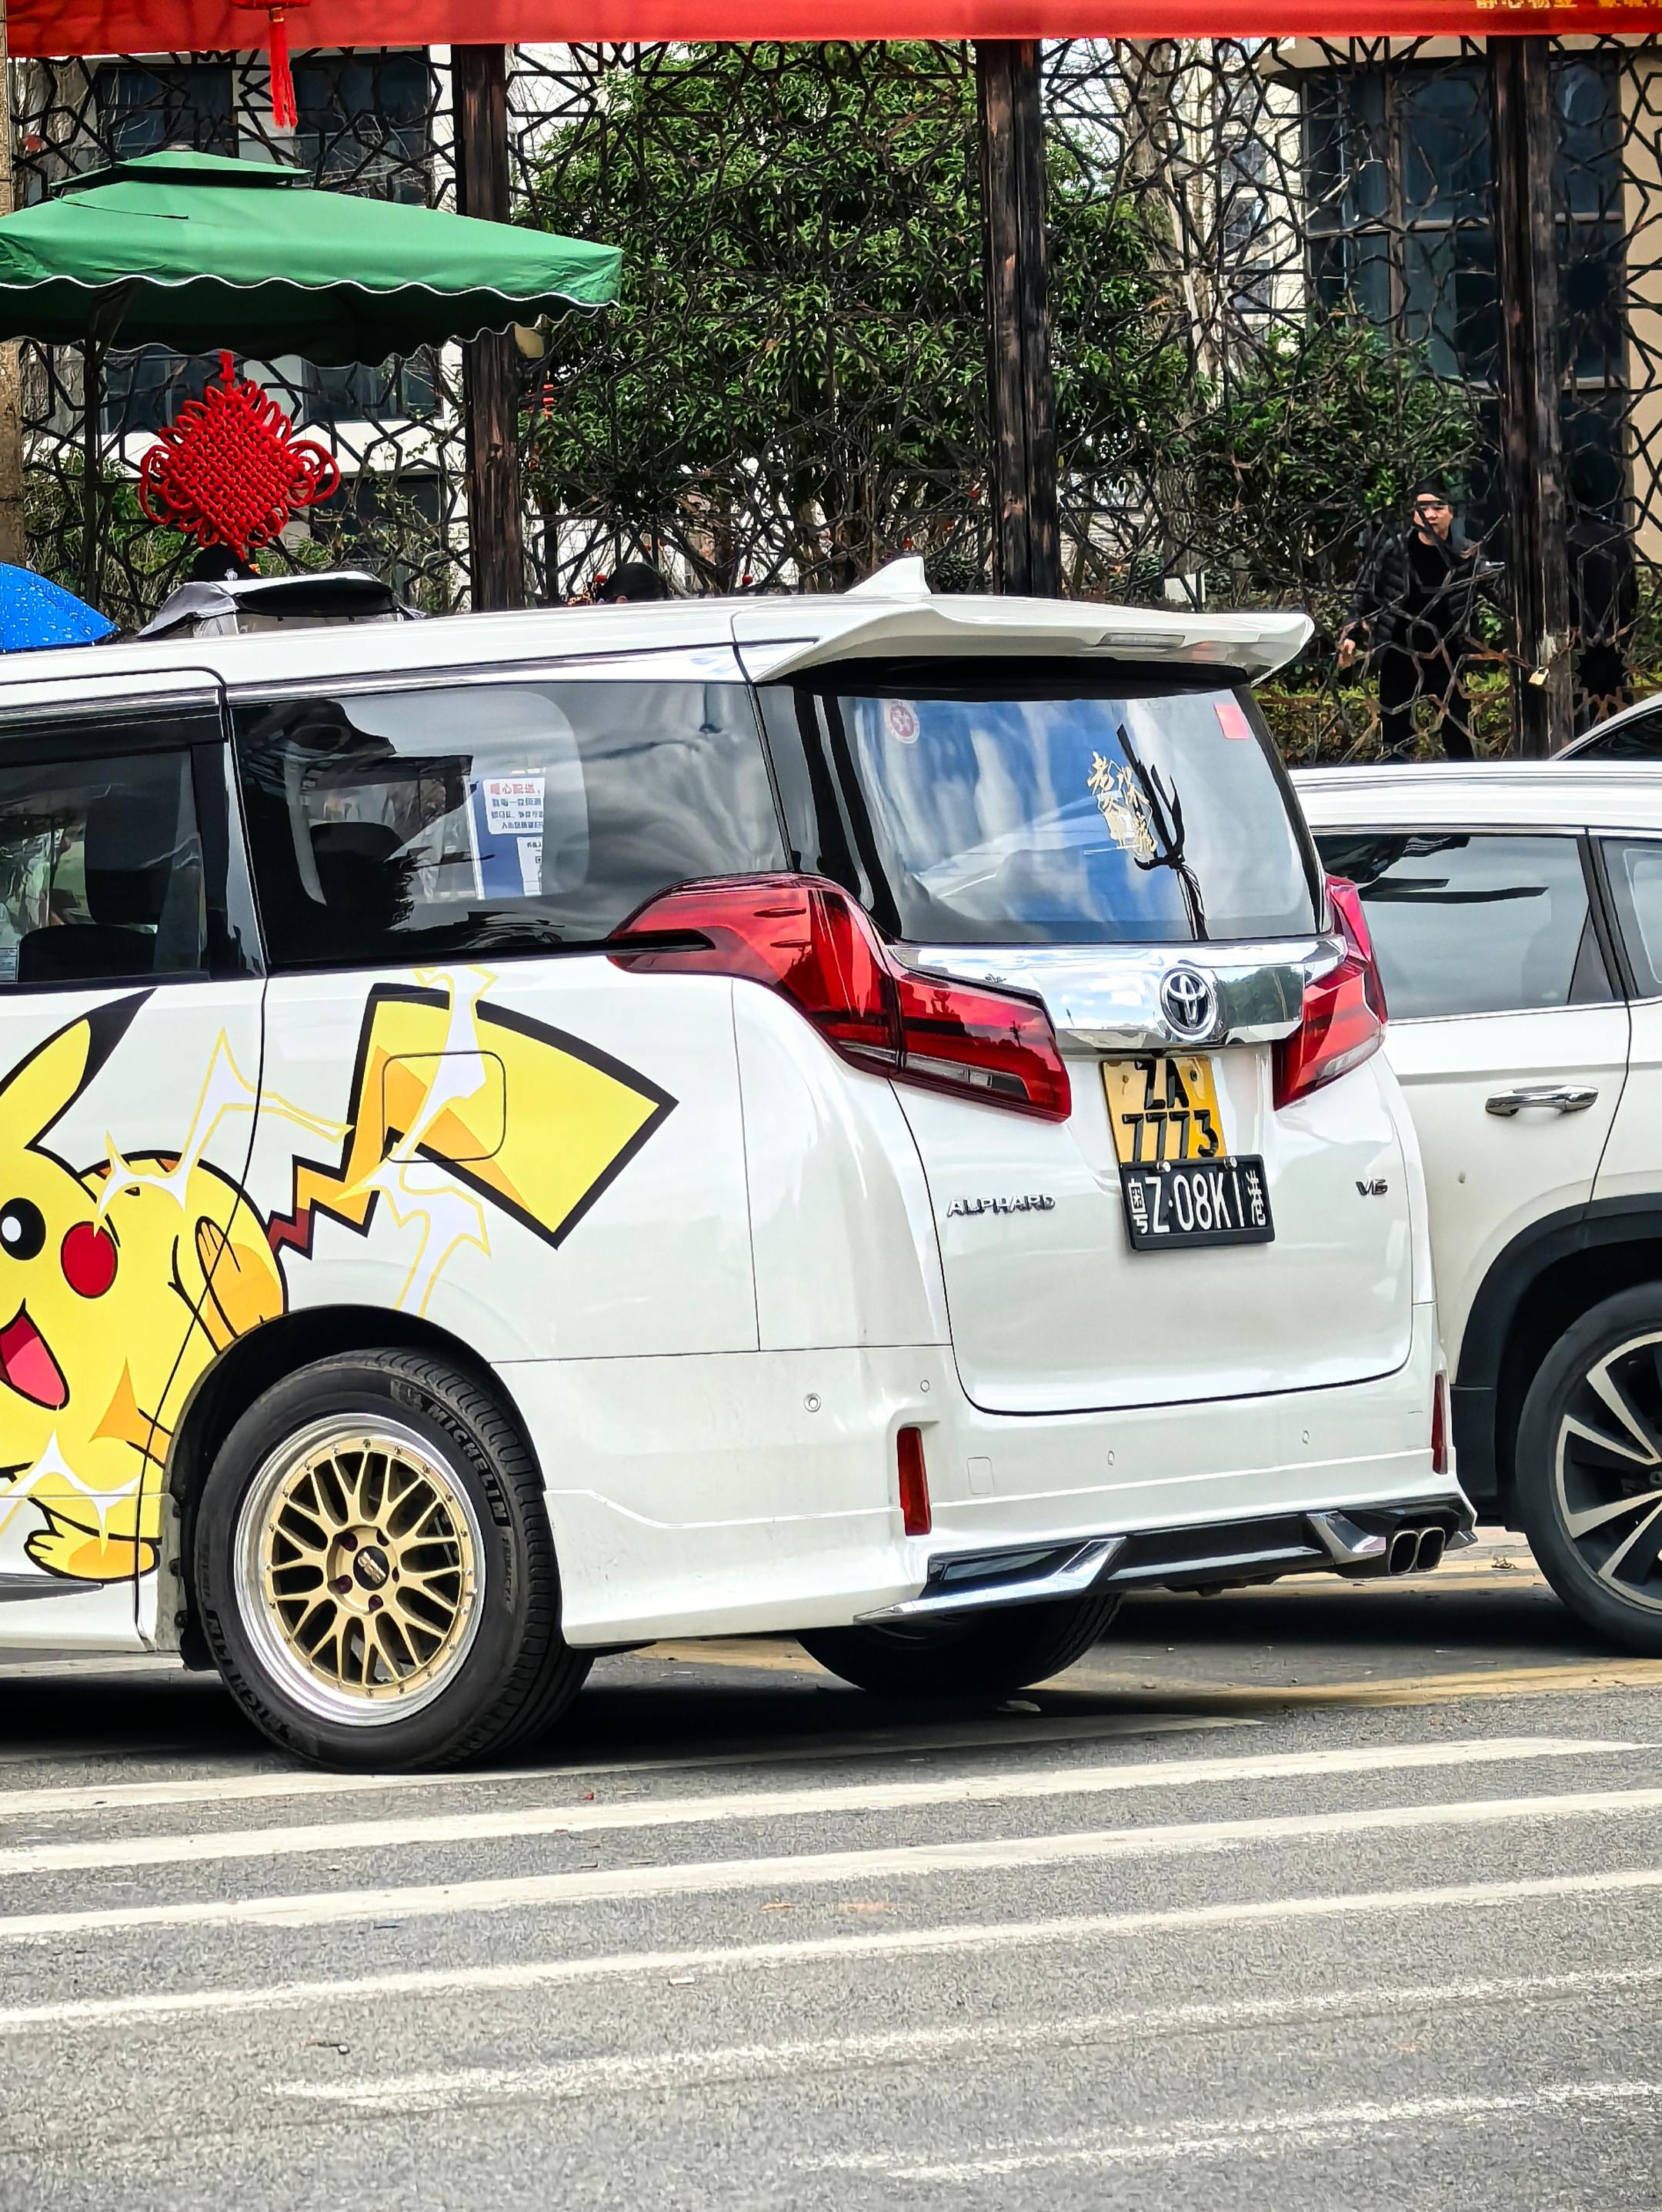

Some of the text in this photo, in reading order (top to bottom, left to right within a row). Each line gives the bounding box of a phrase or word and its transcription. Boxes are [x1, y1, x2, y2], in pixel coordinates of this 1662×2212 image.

[1135, 1058, 1190, 1111] ZA
[1121, 1109, 1220, 1163] 7773
[946, 1194, 1056, 1218] ALPHARD
[1355, 1178, 1388, 1196] V6
[427, 1403, 509, 1519] MICHELIN
